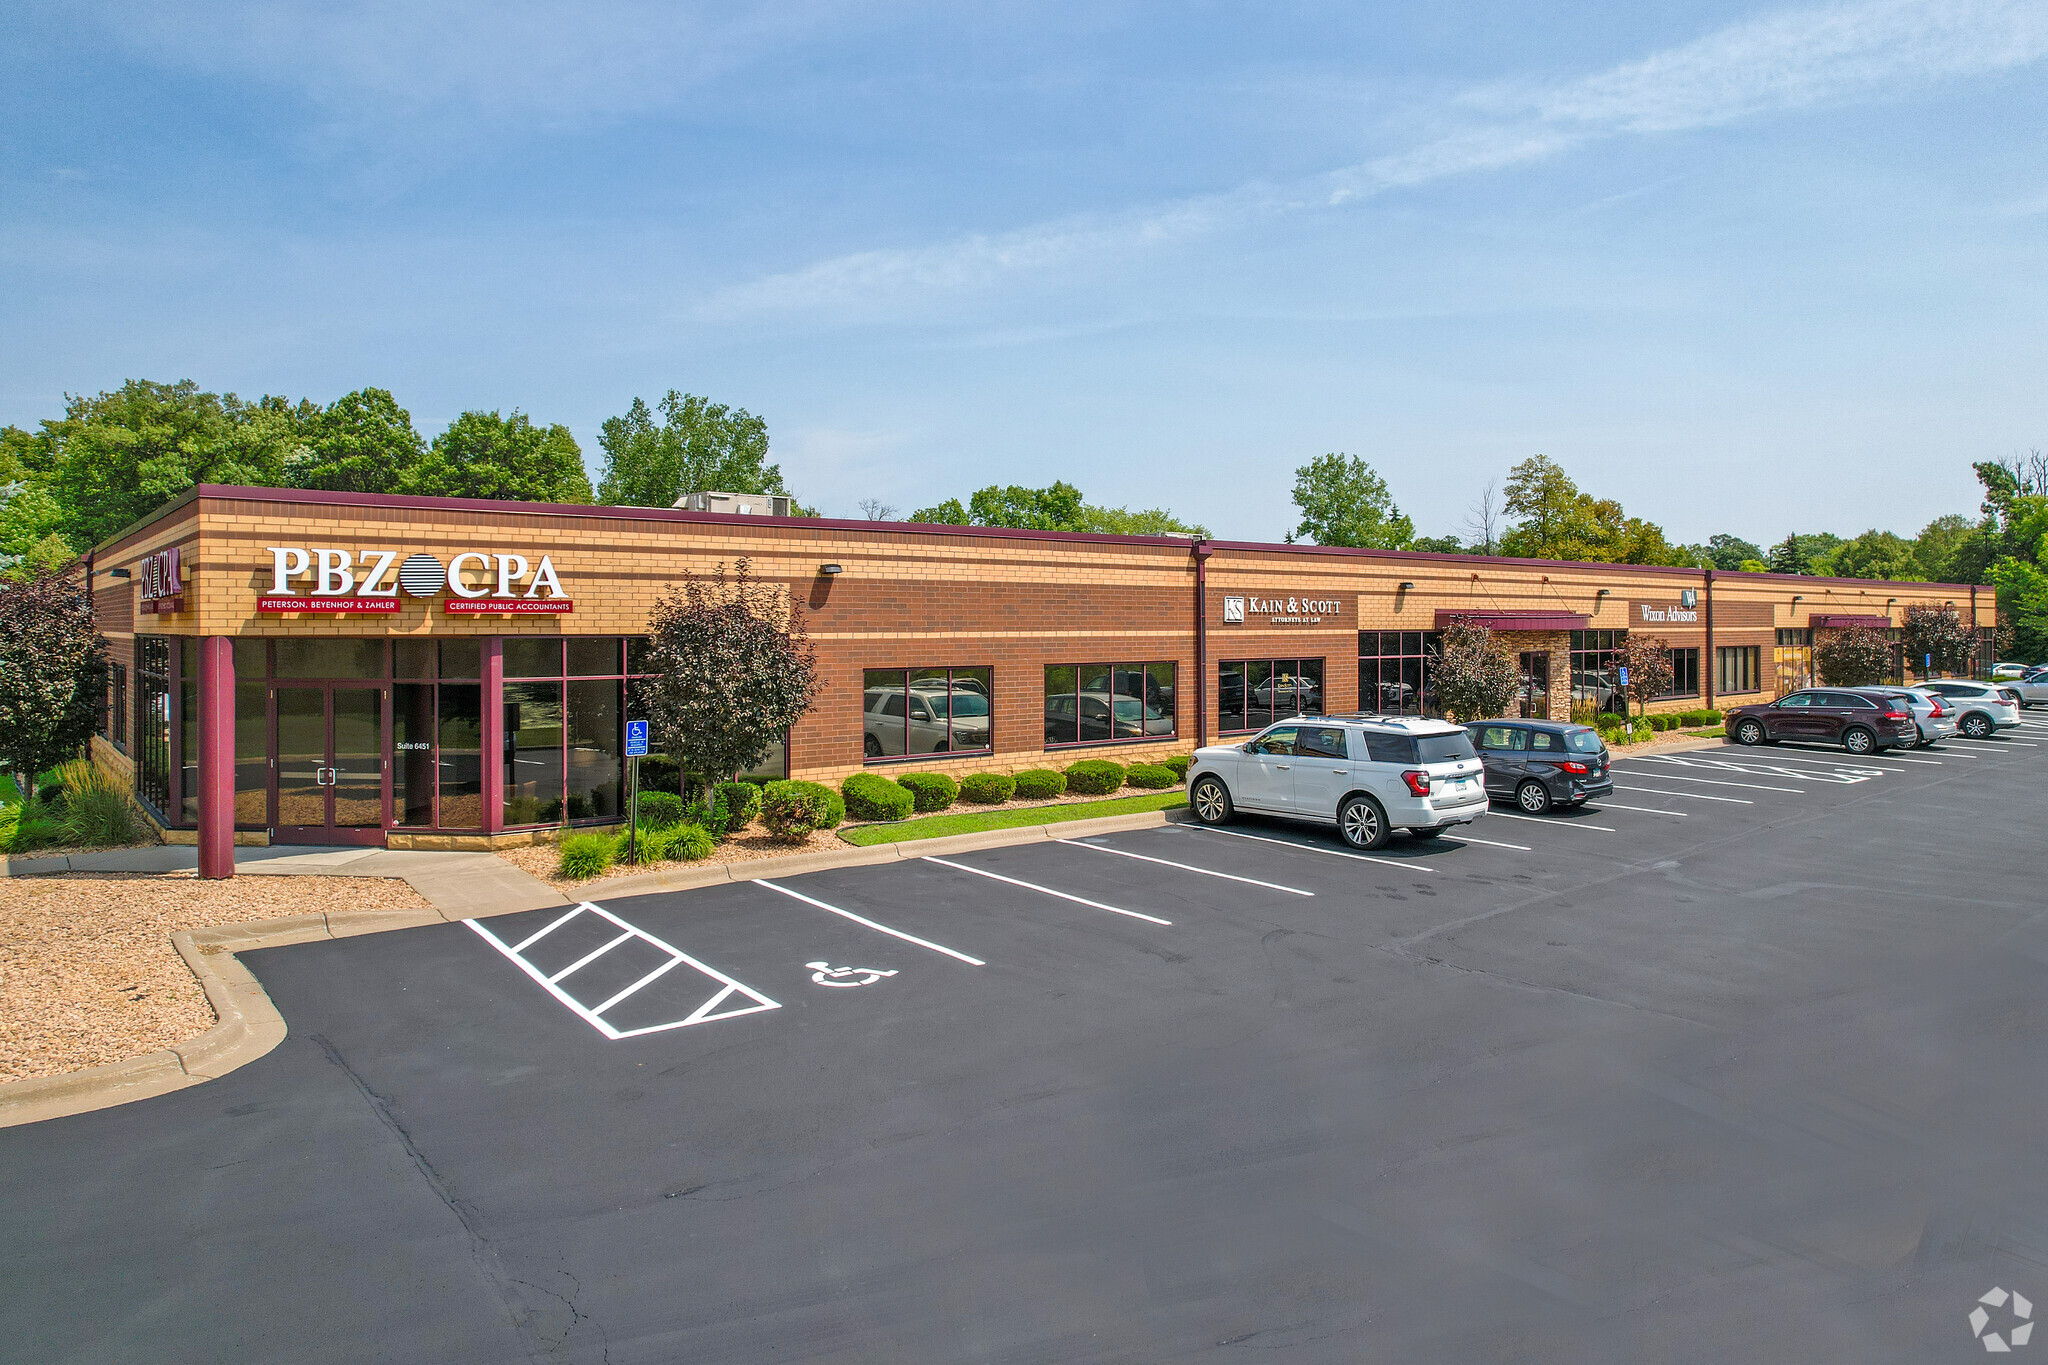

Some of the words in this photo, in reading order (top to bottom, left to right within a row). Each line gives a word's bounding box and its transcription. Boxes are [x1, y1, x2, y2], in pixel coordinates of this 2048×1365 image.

[266, 547, 398, 596] PBZ
[447, 552, 569, 598] CPA
[262, 600, 308, 609] PETERSON,
[311, 601, 354, 609] BEYENHOF
[449, 602, 487, 610] CERTIFIED
[516, 603, 570, 611] ACCOUNTANTS
[1249, 597, 1283, 612] KAIN
[1287, 597, 1298, 613] &
[1302, 598, 1341, 613] SCOTT
[1641, 605, 1665, 621] Wixon
[1667, 605, 1697, 622] Advisors
[396, 742, 413, 750] Suite
[414, 742, 430, 750] 6451
